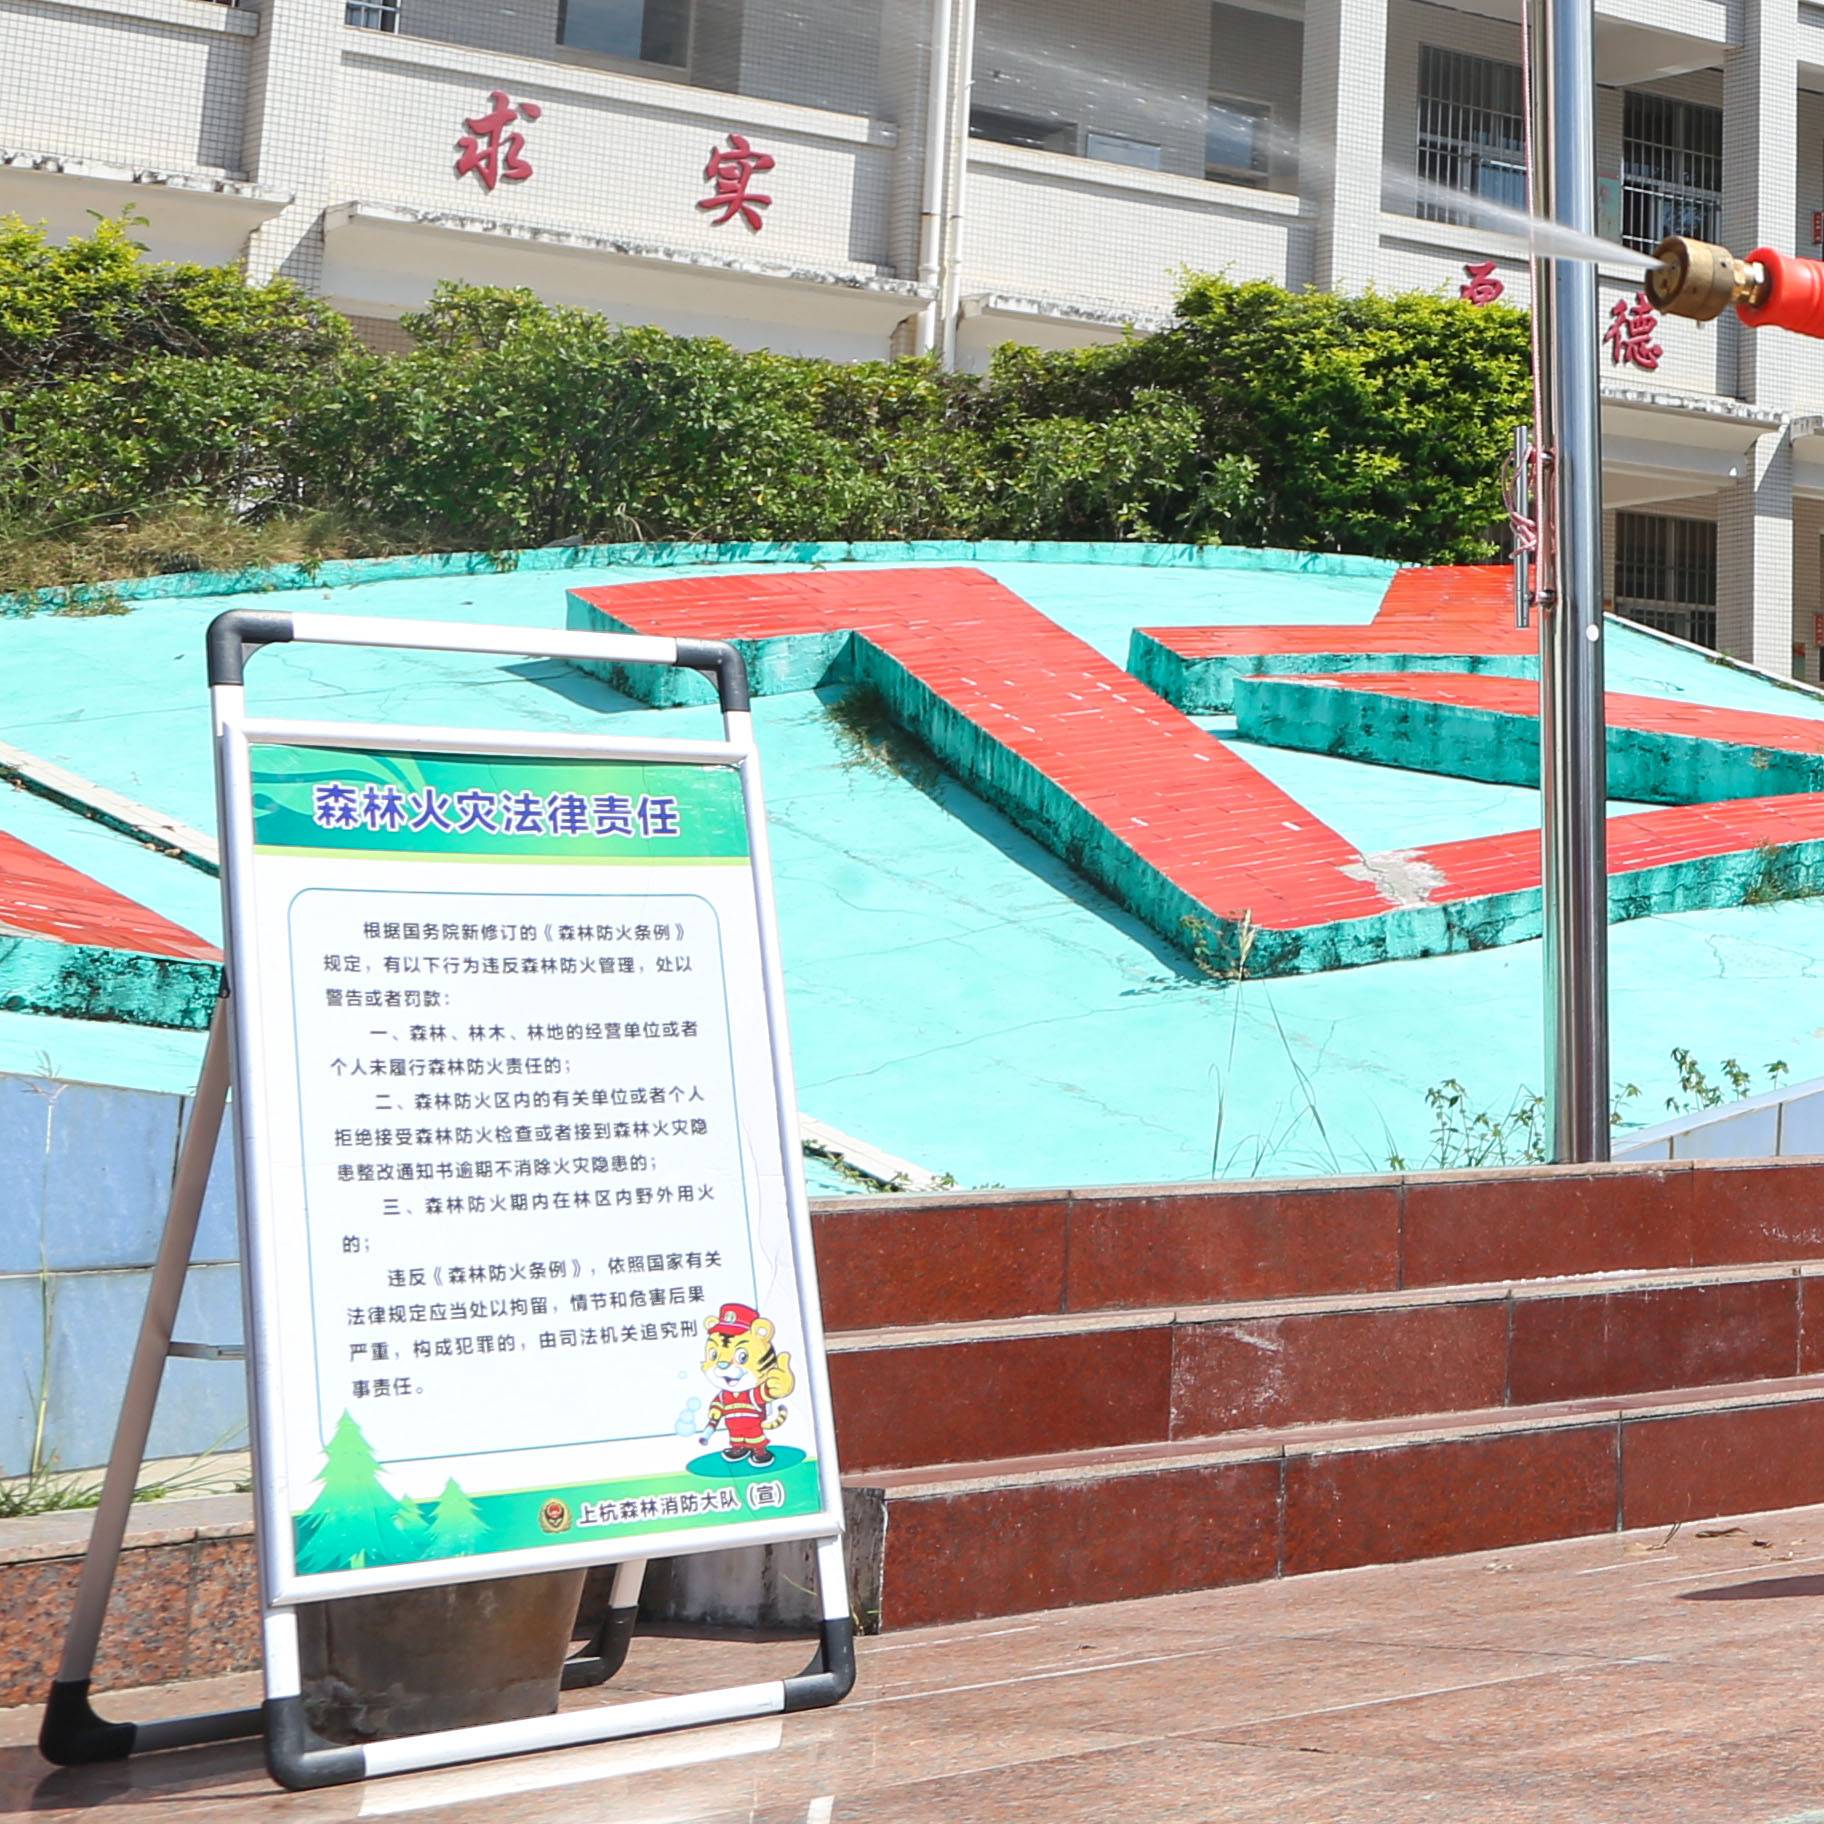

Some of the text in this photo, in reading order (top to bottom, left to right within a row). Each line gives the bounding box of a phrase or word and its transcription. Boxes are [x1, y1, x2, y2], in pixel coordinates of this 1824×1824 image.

[455, 89, 774, 232] 求实
[312, 783, 680, 837] 森林火灾法律责任
[363, 921, 686, 942] 根据国务院新修订的《森林防火条例》
[323, 955, 693, 975] 规定，有以下行为违反森林防火管理，处以
[326, 988, 451, 1008] 警告或者罚款：
[370, 1020, 698, 1042] 一、森林、林木、林地的经营单位或者
[330, 1056, 572, 1077] 个人未履行森林防火责任的；
[375, 1085, 705, 1111] 二、森林防火区内的有关单位或者个人
[334, 1118, 708, 1147] 拒绝接受森林防火检查或者接到森林火灾隐
[337, 1154, 657, 1182] 患整改通知书逾期不消除火灾隐患的；
[383, 1183, 715, 1216] 三、森林防火期内在林区内野外用火
[342, 1234, 373, 1254] 的；
[387, 1250, 723, 1288] 违反《森林防火条例》，依照国家有关
[347, 1285, 705, 1326] 法律规定应当处以拘留，情节和危害后果
[349, 1319, 699, 1362] 严重，构成犯罪的，由司法机关追究刑
[352, 1376, 425, 1399] 事责任。
